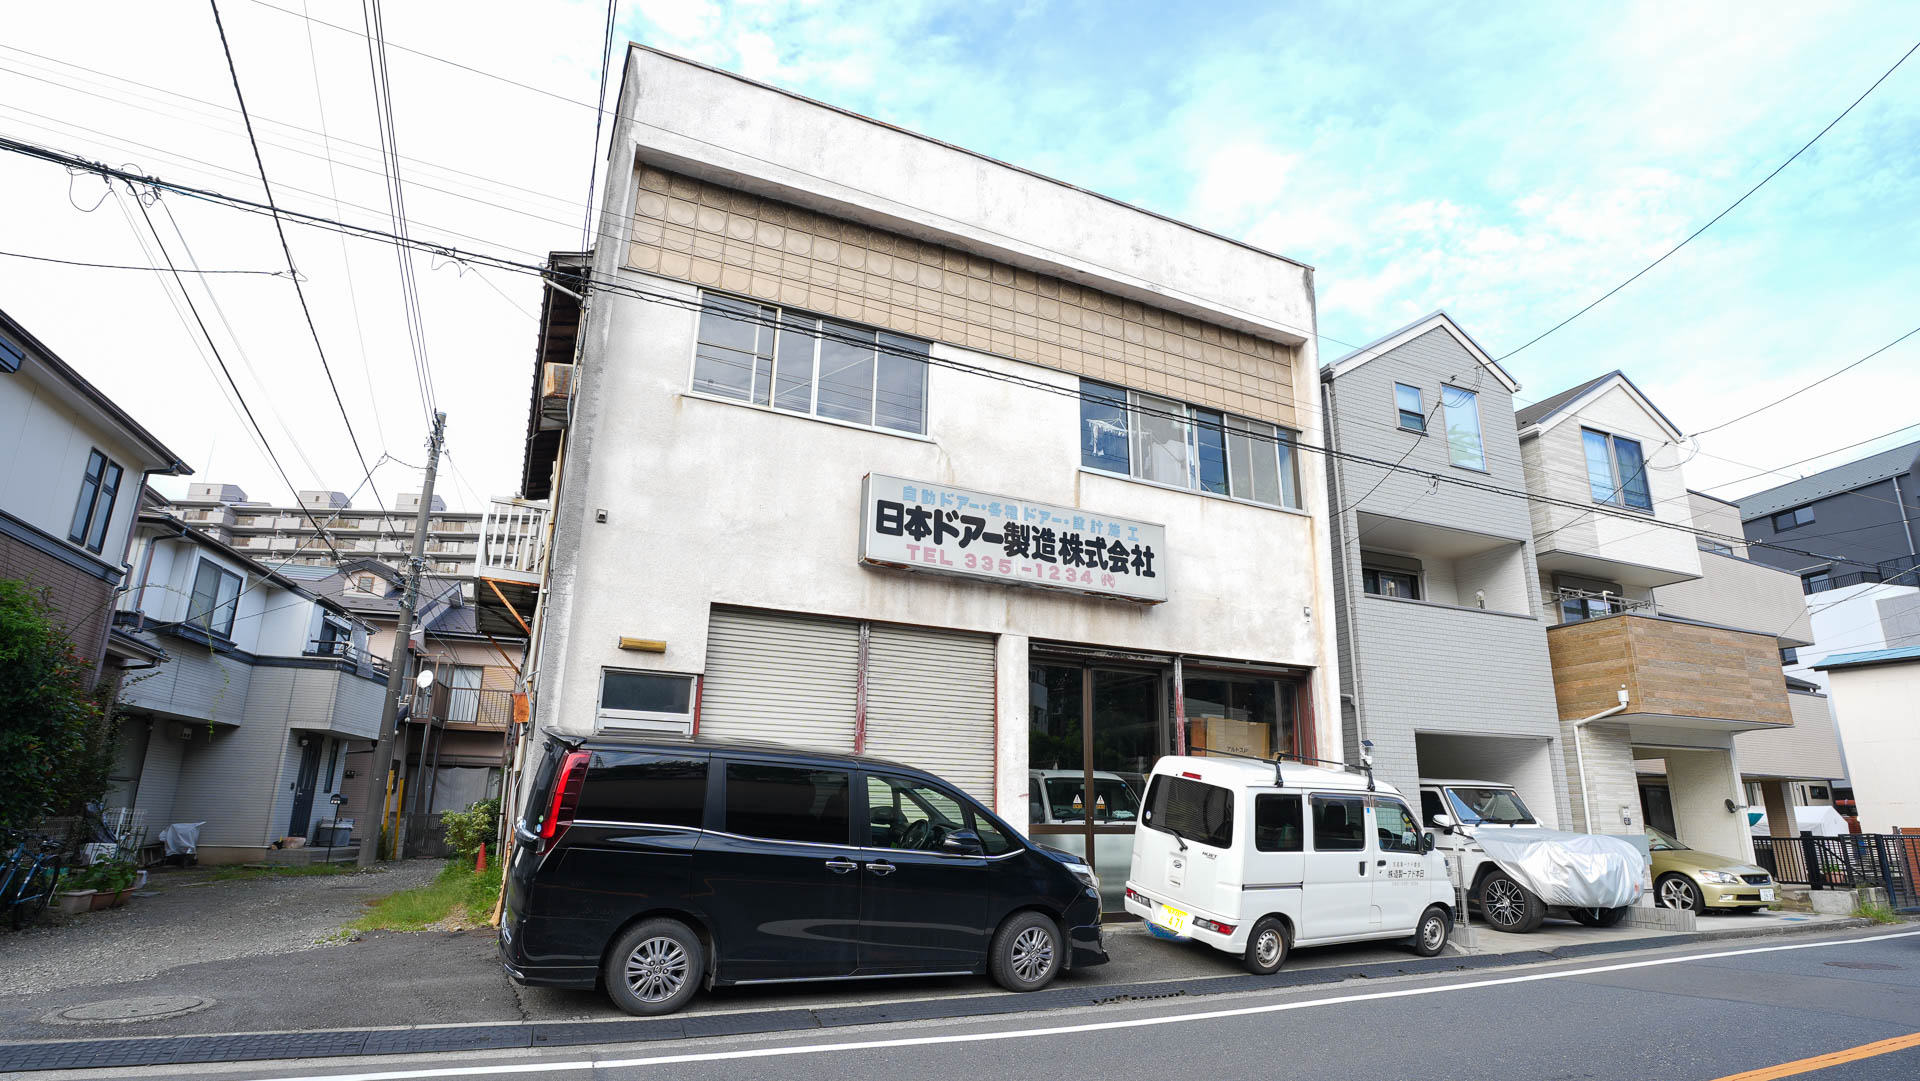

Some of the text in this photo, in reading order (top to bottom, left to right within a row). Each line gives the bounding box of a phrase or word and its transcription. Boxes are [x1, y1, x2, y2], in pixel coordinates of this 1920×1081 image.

[876, 499, 1156, 578] 日本ドアー製造株式会社
[906, 543, 953, 566] TEL
[964, 553, 1093, 584] 335-1234
